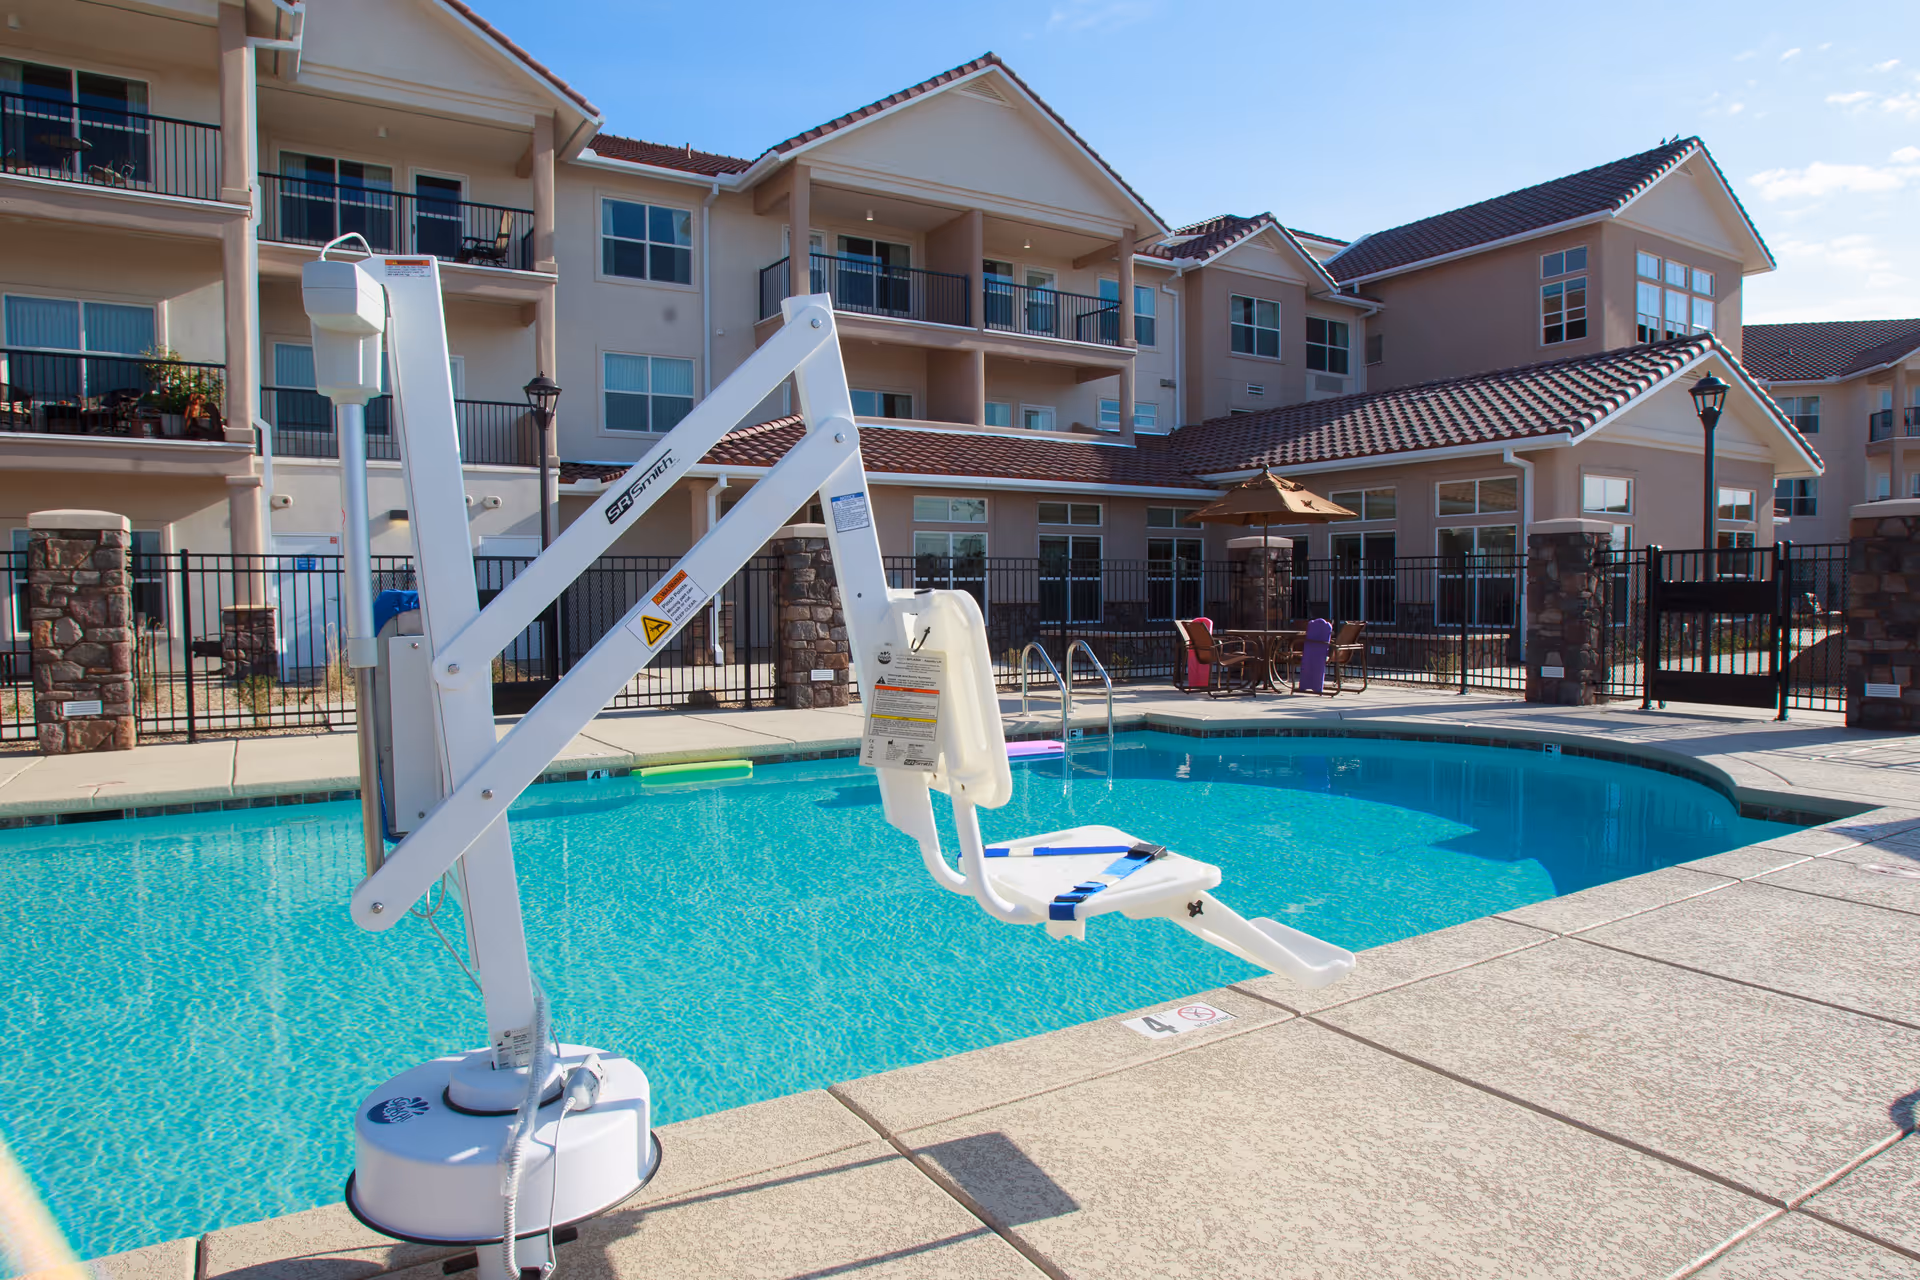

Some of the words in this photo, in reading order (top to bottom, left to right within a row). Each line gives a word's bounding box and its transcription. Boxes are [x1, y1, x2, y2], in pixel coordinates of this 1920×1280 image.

[631, 457, 673, 499] Smith
[659, 572, 685, 597] WARNING
[661, 595, 674, 609] Pinch
[666, 599, 680, 613] Moving
[685, 586, 693, 594] can
[670, 605, 681, 617] crush
[674, 610, 685, 621] KEEP
[683, 599, 697, 612] CLEAR
[1141, 1016, 1179, 1034] 4
[1208, 1015, 1233, 1025] DIVING
